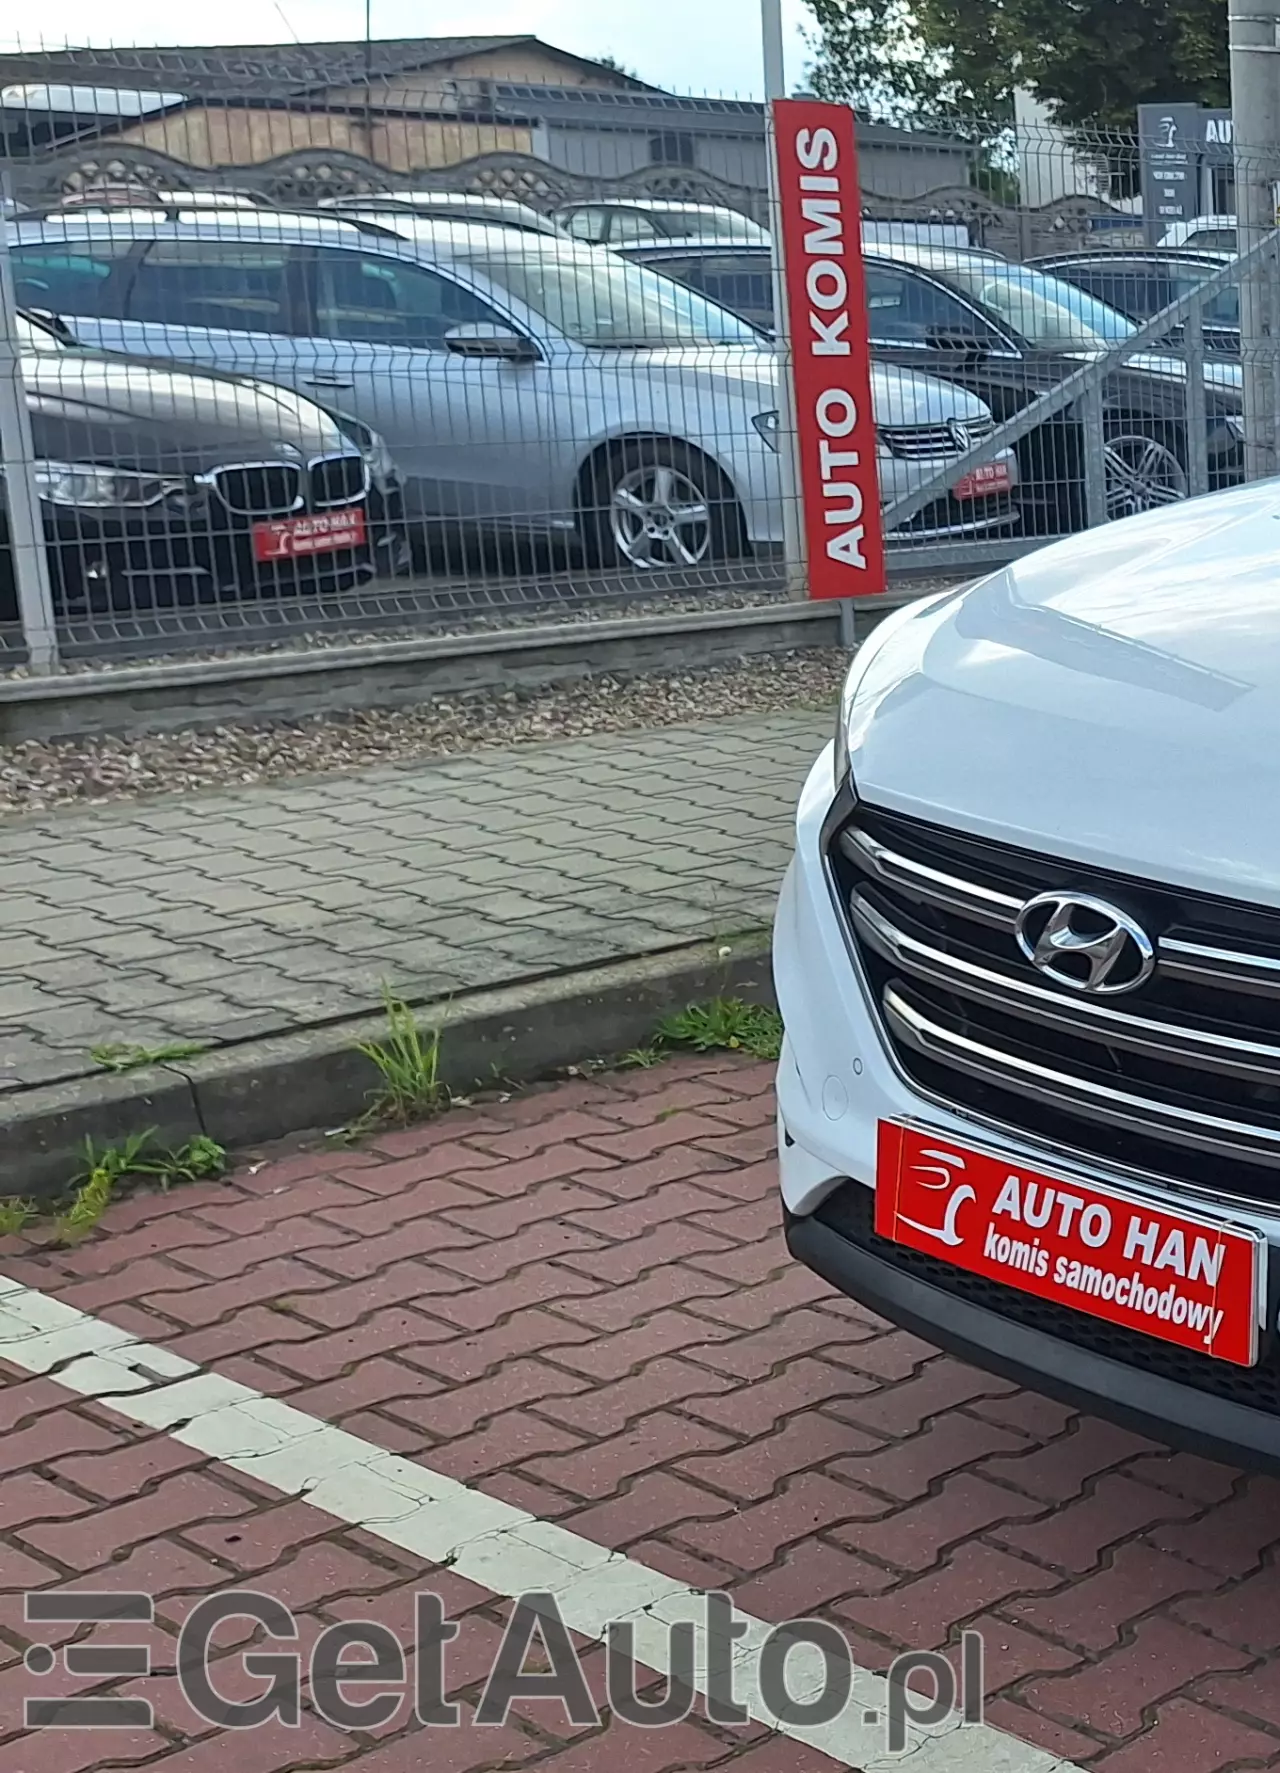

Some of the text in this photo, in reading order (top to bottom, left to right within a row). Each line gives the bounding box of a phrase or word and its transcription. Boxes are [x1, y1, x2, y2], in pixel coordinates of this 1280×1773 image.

[796, 127, 867, 570] AUTO KOMIS
[983, 1223, 1223, 1345] komis samochodowy
[992, 1175, 1226, 1288] AUTO HAN
